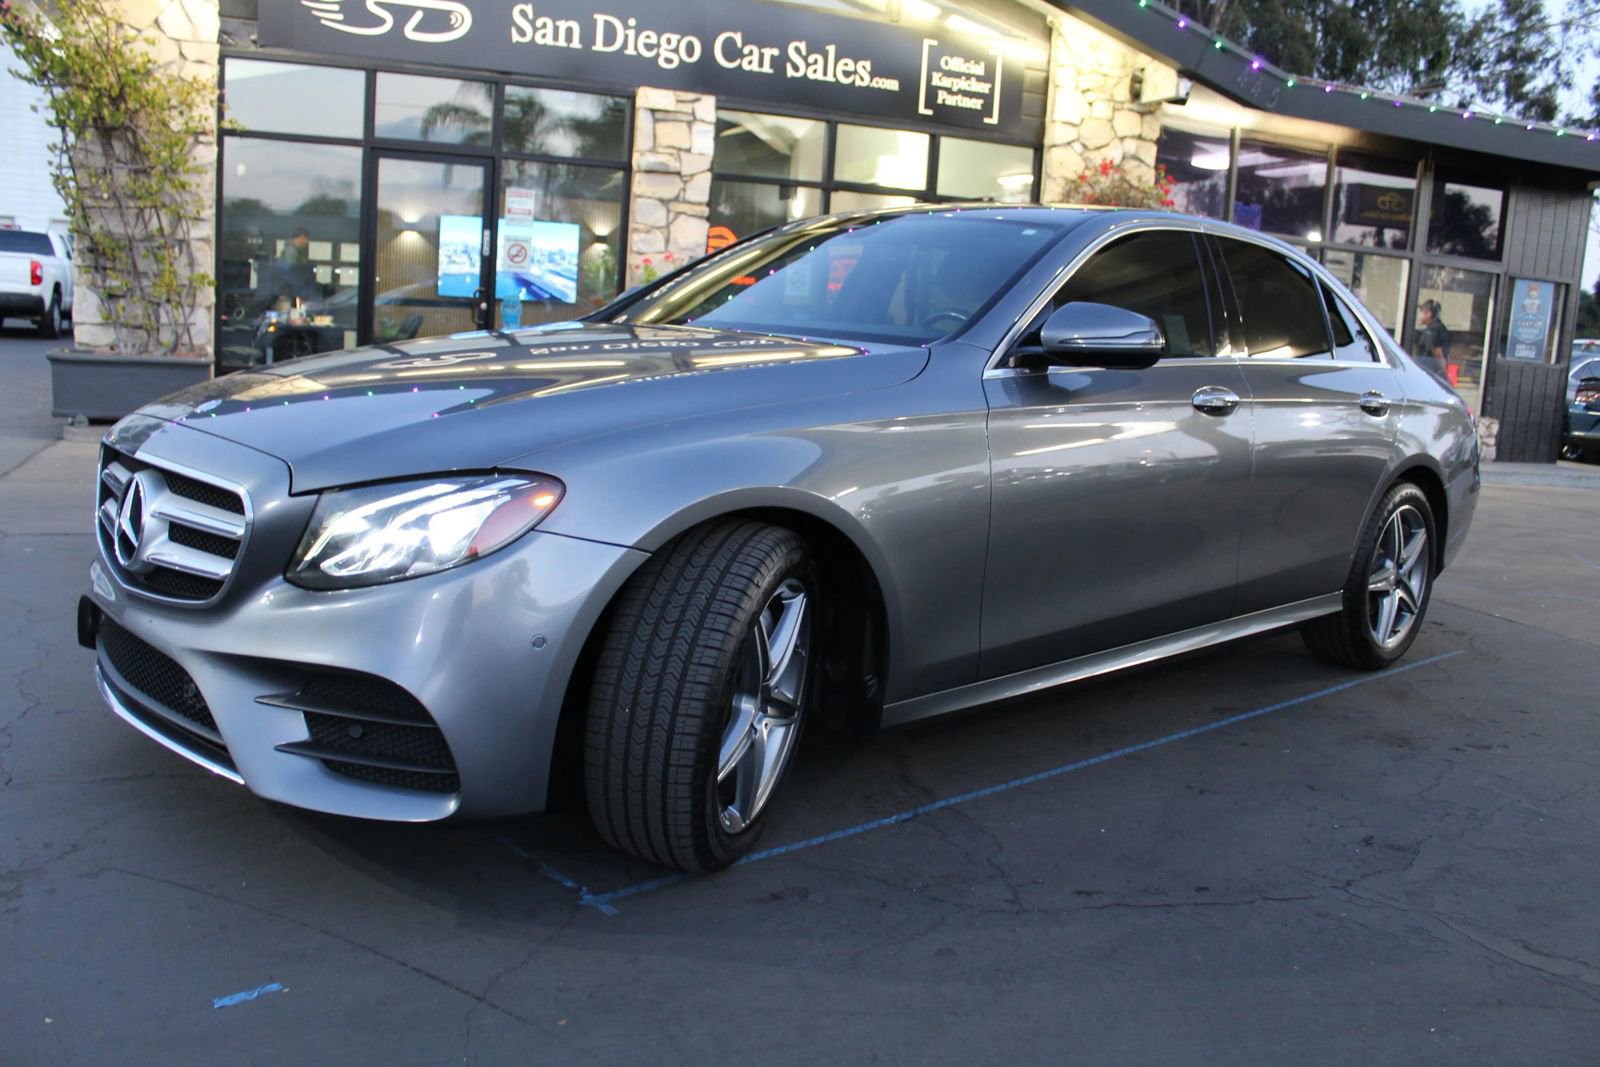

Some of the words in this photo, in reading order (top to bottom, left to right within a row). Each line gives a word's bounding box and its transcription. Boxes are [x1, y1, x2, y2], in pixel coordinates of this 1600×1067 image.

[511, 3, 583, 49] San
[592, 13, 702, 70] Diego
[713, 31, 780, 74] Car
[940, 55, 985, 76] Official
[936, 89, 984, 110] Partner
